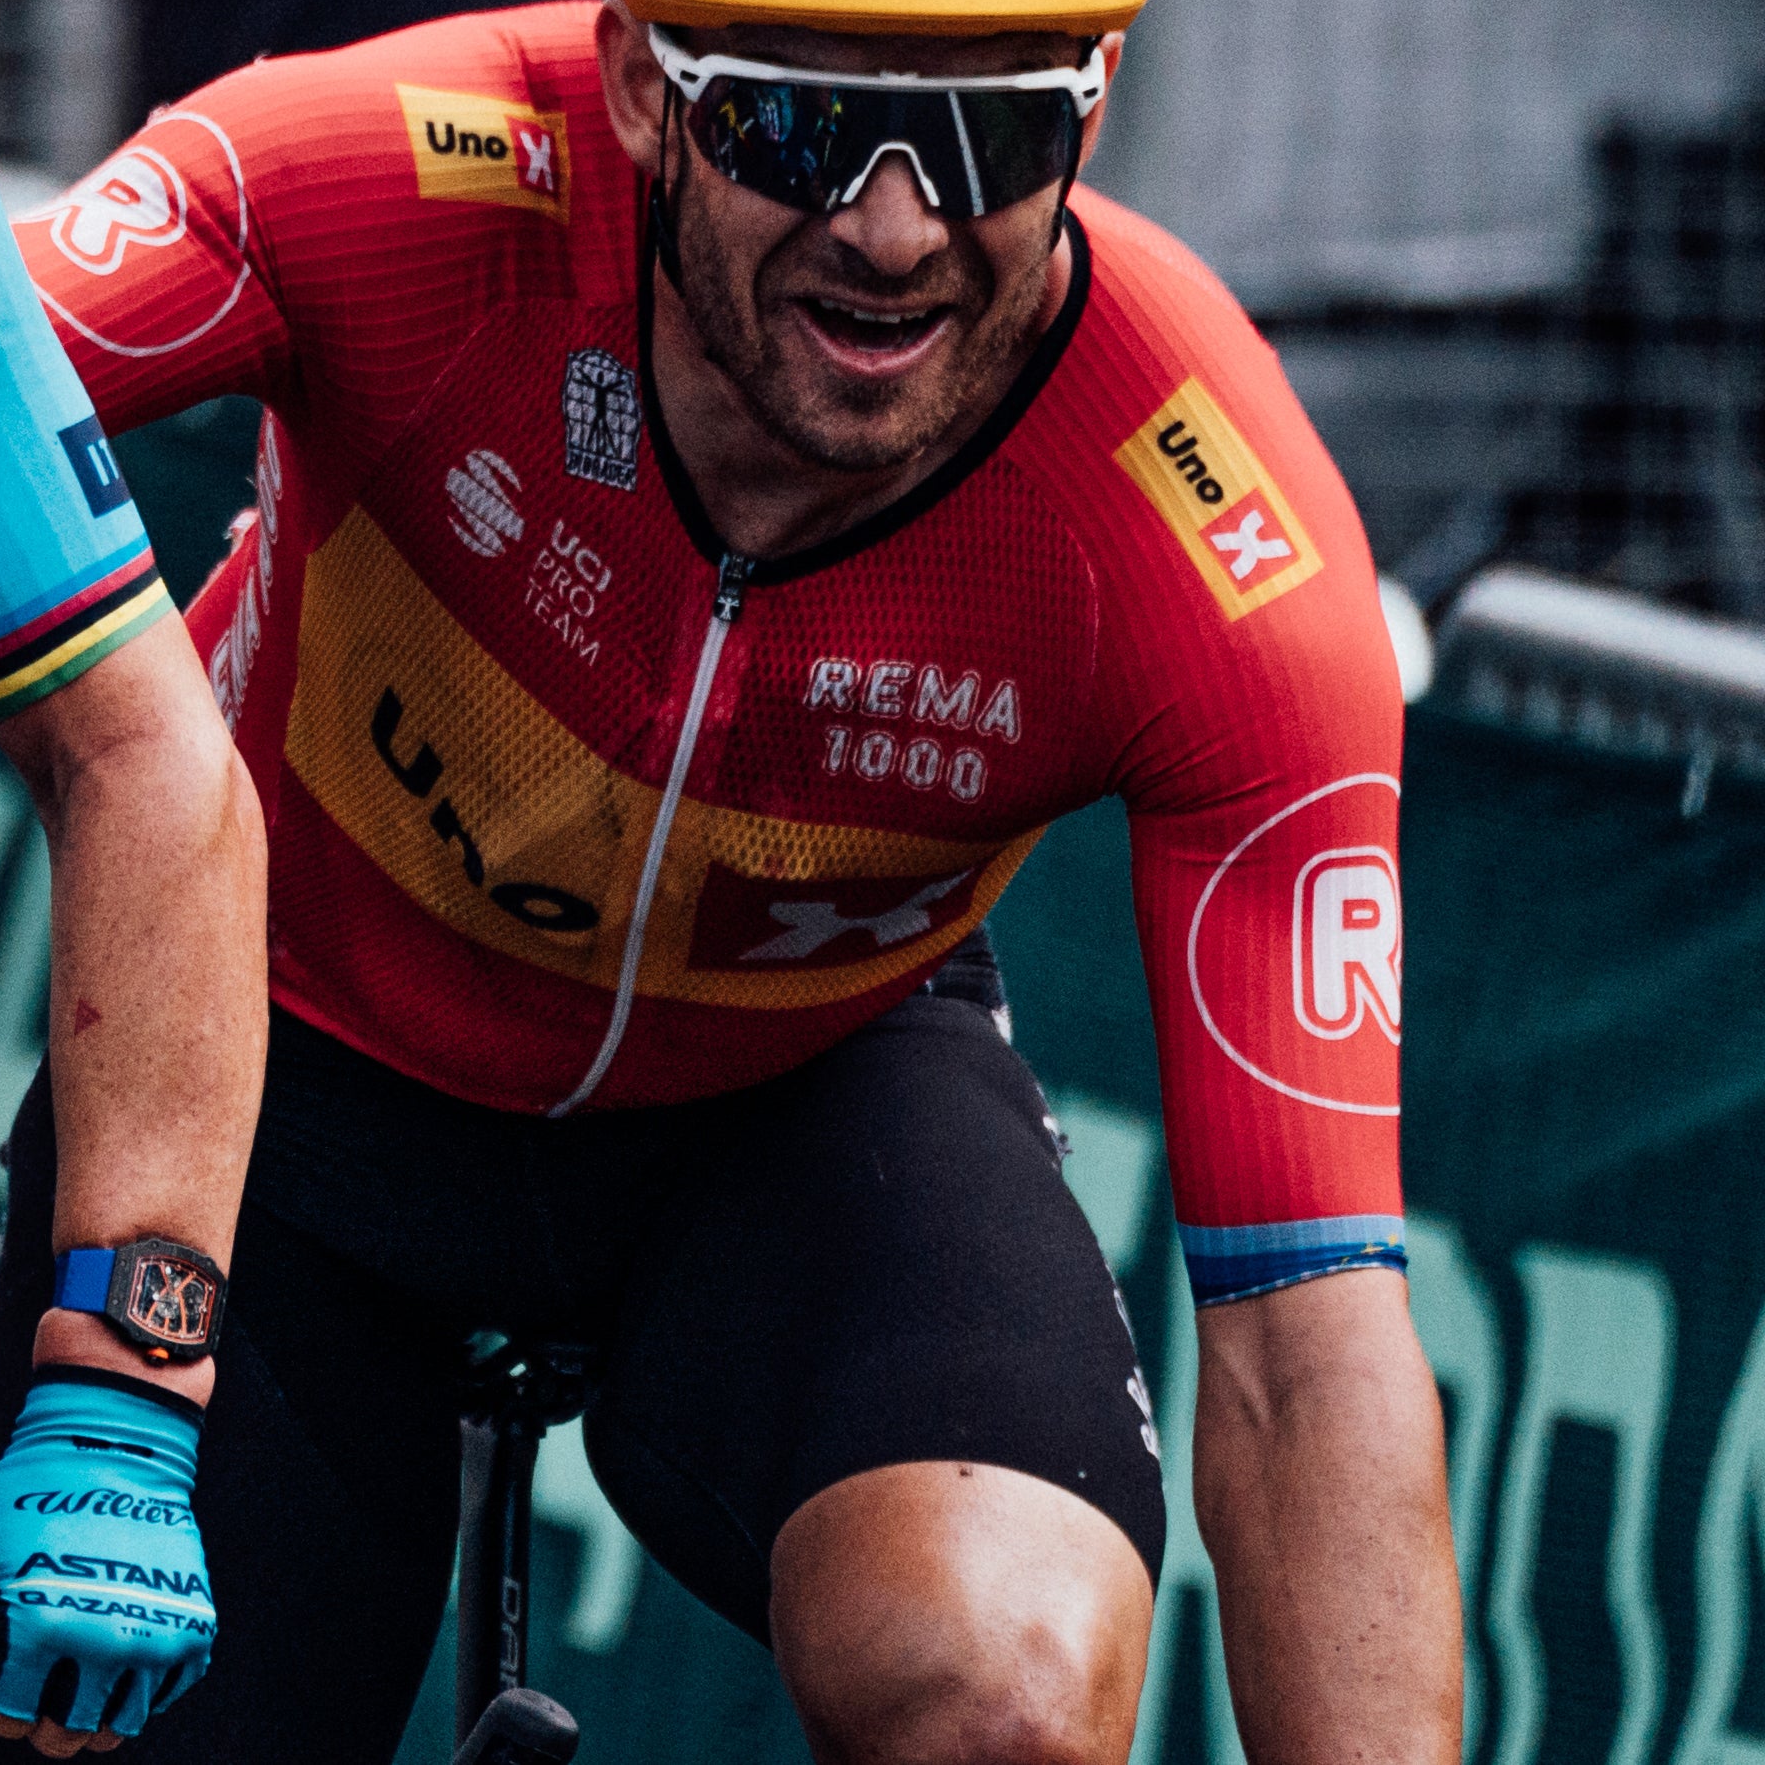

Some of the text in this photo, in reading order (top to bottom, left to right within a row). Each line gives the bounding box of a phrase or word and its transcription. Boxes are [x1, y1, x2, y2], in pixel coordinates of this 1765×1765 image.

[425, 121, 557, 192] Uno X
[1157, 420, 1292, 581] Uno X
[533, 548, 597, 618] PRO
[551, 520, 613, 594] UCI
[524, 576, 600, 667] TEAM
[805, 657, 1022, 743] REMA
[821, 726, 990, 804] 1000
[13, 1487, 193, 1526] Wilier
[14, 1551, 215, 1604] ASTANA
[18, 1590, 217, 1639] QAZAQSTAN
